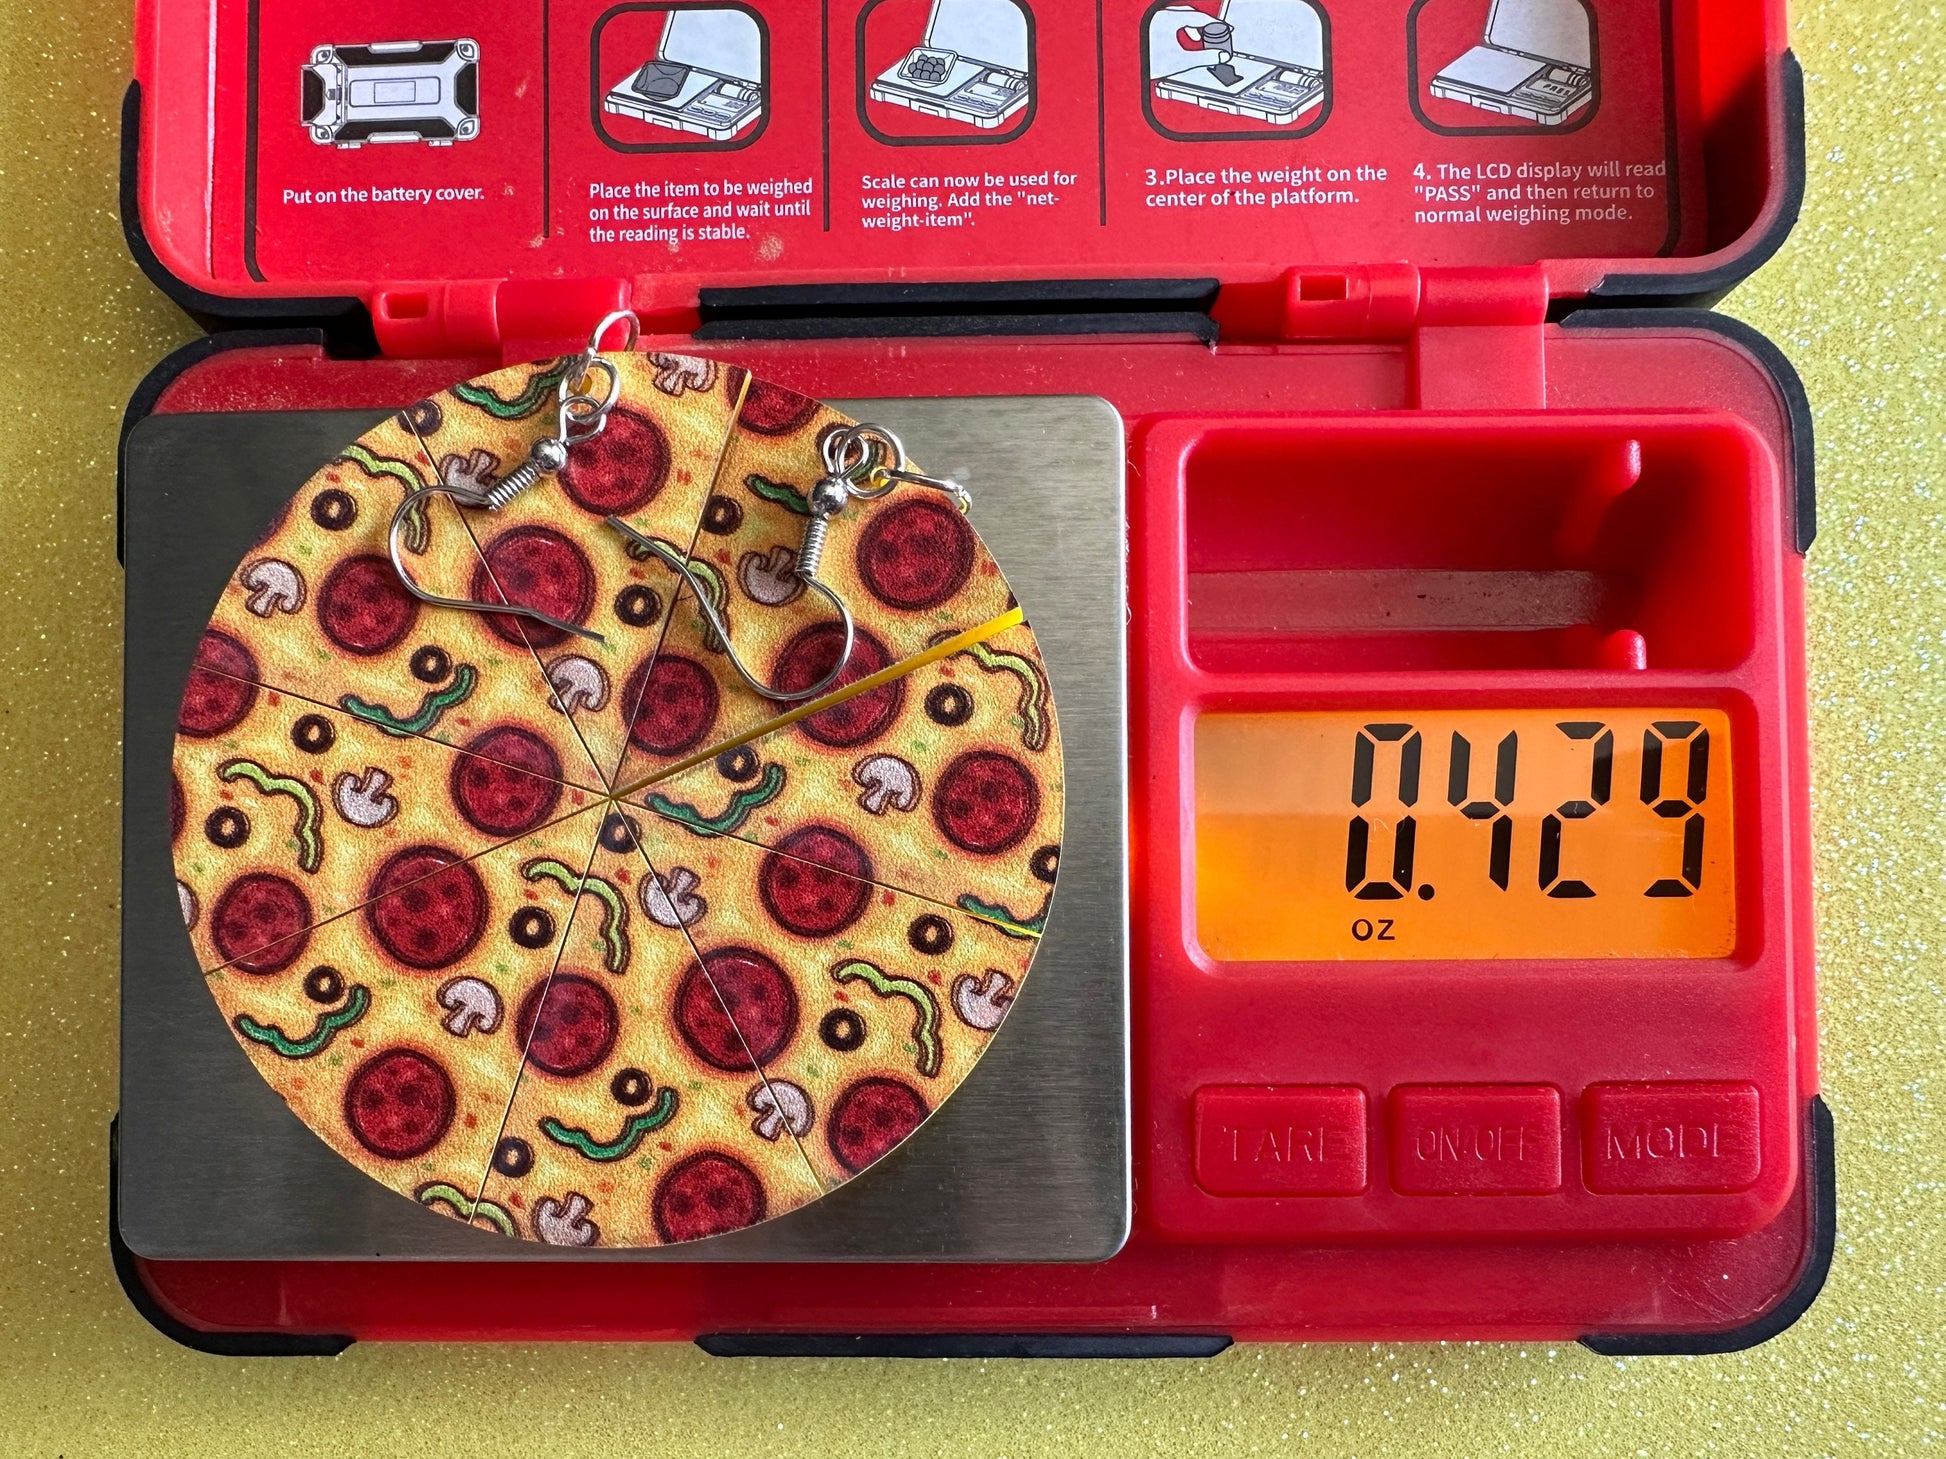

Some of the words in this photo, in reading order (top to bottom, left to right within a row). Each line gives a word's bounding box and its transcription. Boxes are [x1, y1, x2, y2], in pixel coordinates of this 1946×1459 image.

[861, 173, 906, 190] Scale
[909, 176, 940, 189] can
[943, 175, 980, 188] now
[984, 171, 1005, 187] be
[1008, 170, 1049, 187] used
[1052, 170, 1078, 186] for
[1144, 167, 1216, 187] 3.Place
[1220, 166, 1253, 185] the
[1256, 165, 1323, 187] weight
[1326, 168, 1351, 182] on
[1355, 164, 1388, 182] the
[1412, 162, 1432, 181] 4.
[1436, 162, 1472, 180] The
[1476, 163, 1512, 180] LCD
[1516, 161, 1583, 182] display
[1587, 160, 1620, 177] will
[1625, 159, 1666, 177] read
[282, 188, 313, 205] Put
[314, 190, 337, 204] on
[339, 186, 369, 203] the
[371, 185, 433, 205] battery
[435, 187, 485, 201] cover.
[589, 181, 632, 199] Place
[633, 180, 661, 198] the
[664, 179, 700, 198] item
[702, 180, 720, 197] to
[723, 178, 743, 196] be
[746, 176, 813, 199] weighed
[1145, 191, 1207, 208] center
[1210, 188, 1231, 206] of
[1233, 188, 1266, 206] the
[1271, 186, 1360, 209] platform.
[1414, 184, 1481, 203] "PASS"
[1486, 183, 1521, 201] and
[1525, 183, 1568, 200] then
[1573, 184, 1631, 199] return
[1635, 184, 1655, 199] to
[588, 207, 610, 221] on
[612, 203, 640, 221] the
[642, 201, 700, 220] surface
[702, 200, 732, 218] and
[735, 199, 771, 218] wait
[774, 198, 811, 217] until
[861, 192, 943, 213] weighing.
[947, 191, 981, 208] Add
[984, 190, 1013, 207] the
[1017, 190, 1060, 206] "net-
[861, 211, 976, 232] weight-item".
[1414, 205, 1482, 224] normal
[1485, 204, 1571, 226] weighing
[1575, 203, 1633, 221] mode.
[588, 225, 616, 244] the
[619, 224, 679, 245] reading
[681, 223, 695, 241] is
[697, 222, 751, 241] stable.
[1345, 721, 1711, 901] 0.429
[1222, 1126, 1352, 1162] TARE
[1606, 1122, 1738, 1160] MODE
